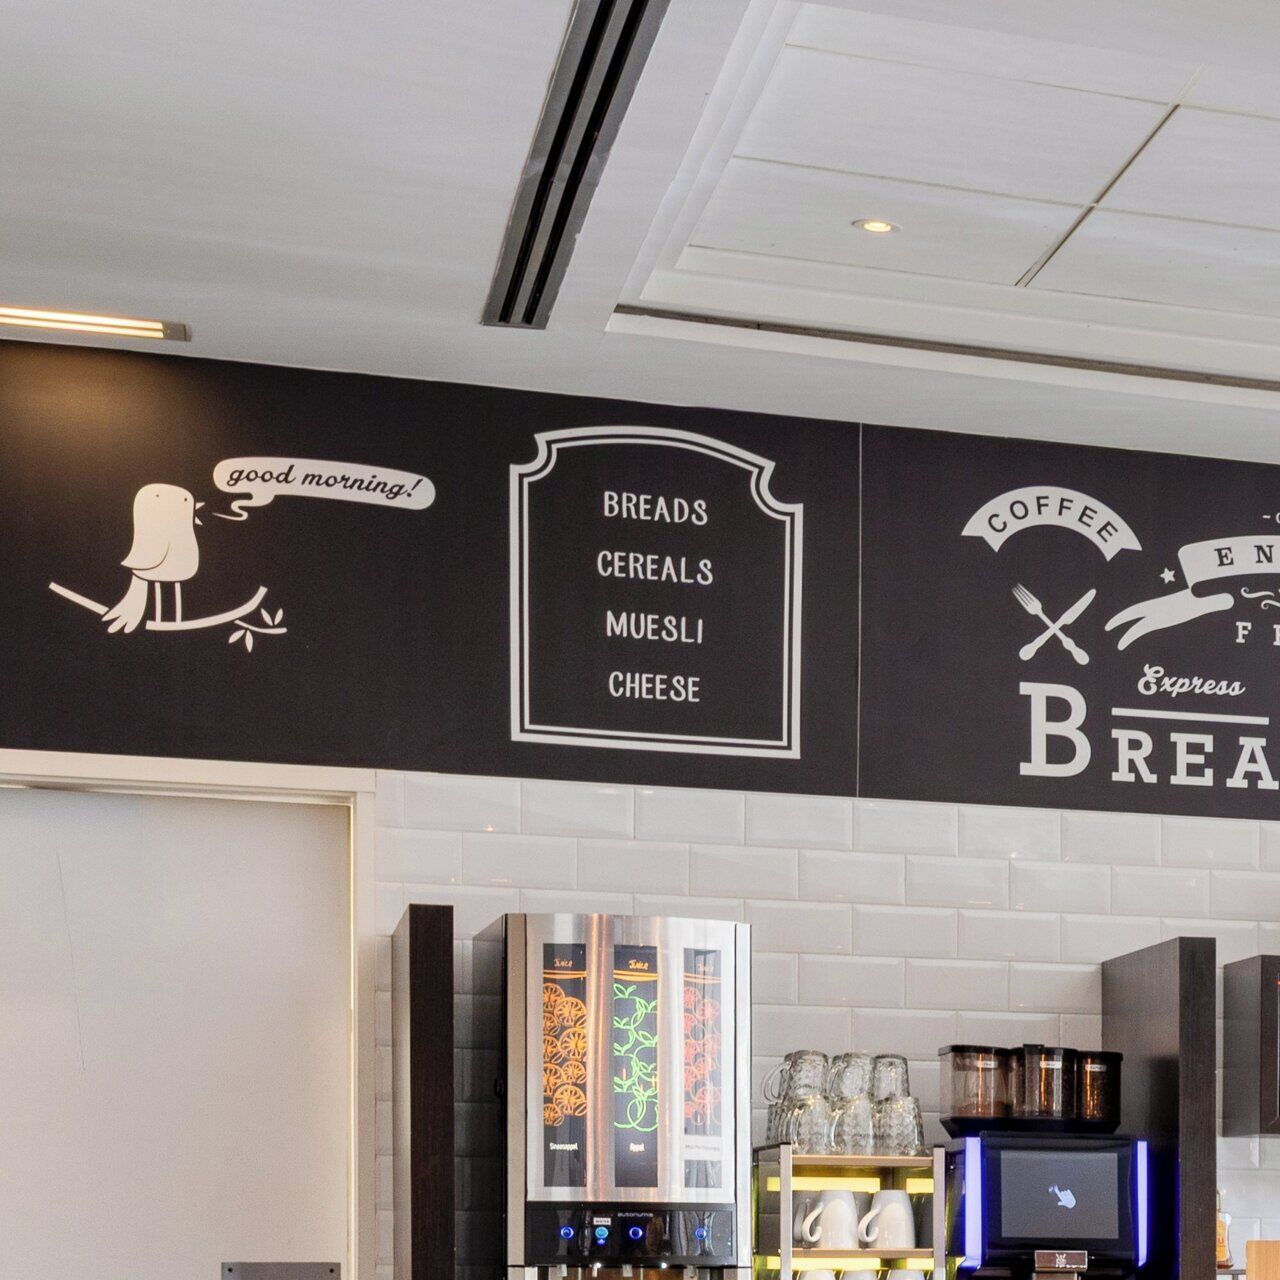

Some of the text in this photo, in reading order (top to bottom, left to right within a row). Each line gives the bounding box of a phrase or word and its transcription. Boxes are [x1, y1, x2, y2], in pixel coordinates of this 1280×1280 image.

[226, 464, 424, 500] good morning!
[604, 491, 708, 526] BREADS
[988, 496, 1118, 542] COFFEE
[597, 550, 714, 586] CEREALS
[606, 610, 703, 644] MUESLI
[608, 671, 700, 703] CHEESE
[1136, 663, 1246, 698] Express
